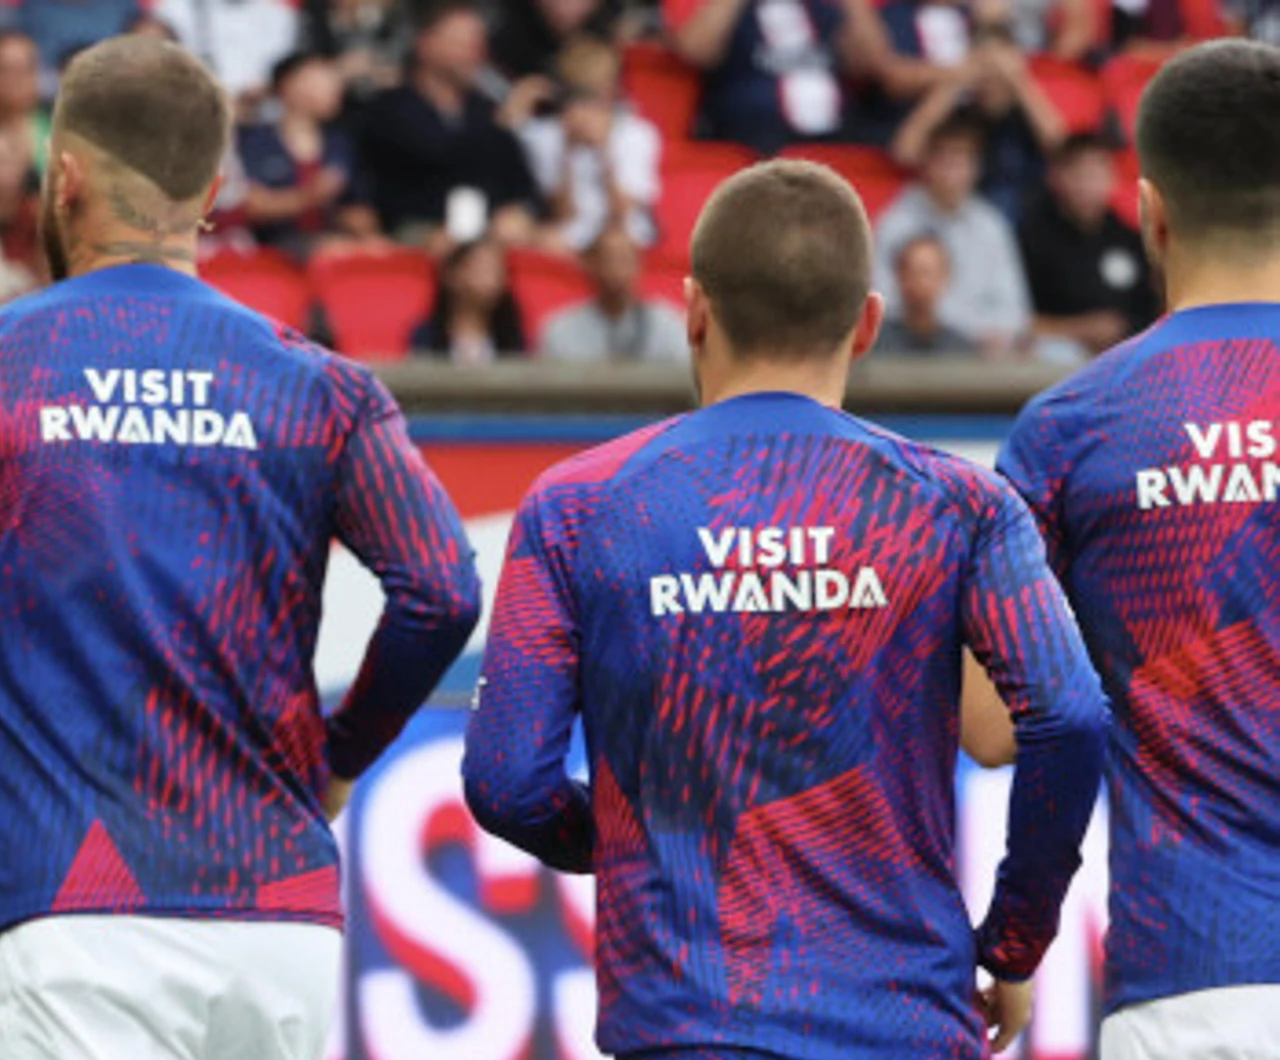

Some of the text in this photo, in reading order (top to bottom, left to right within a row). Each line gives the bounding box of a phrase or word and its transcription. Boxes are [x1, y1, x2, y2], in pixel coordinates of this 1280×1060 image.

[84, 367, 213, 406] VISIT
[40, 404, 257, 450] RWANDA
[1184, 419, 1278, 459] VIS
[697, 526, 835, 567] VISIT
[649, 565, 889, 616] RWANDA
